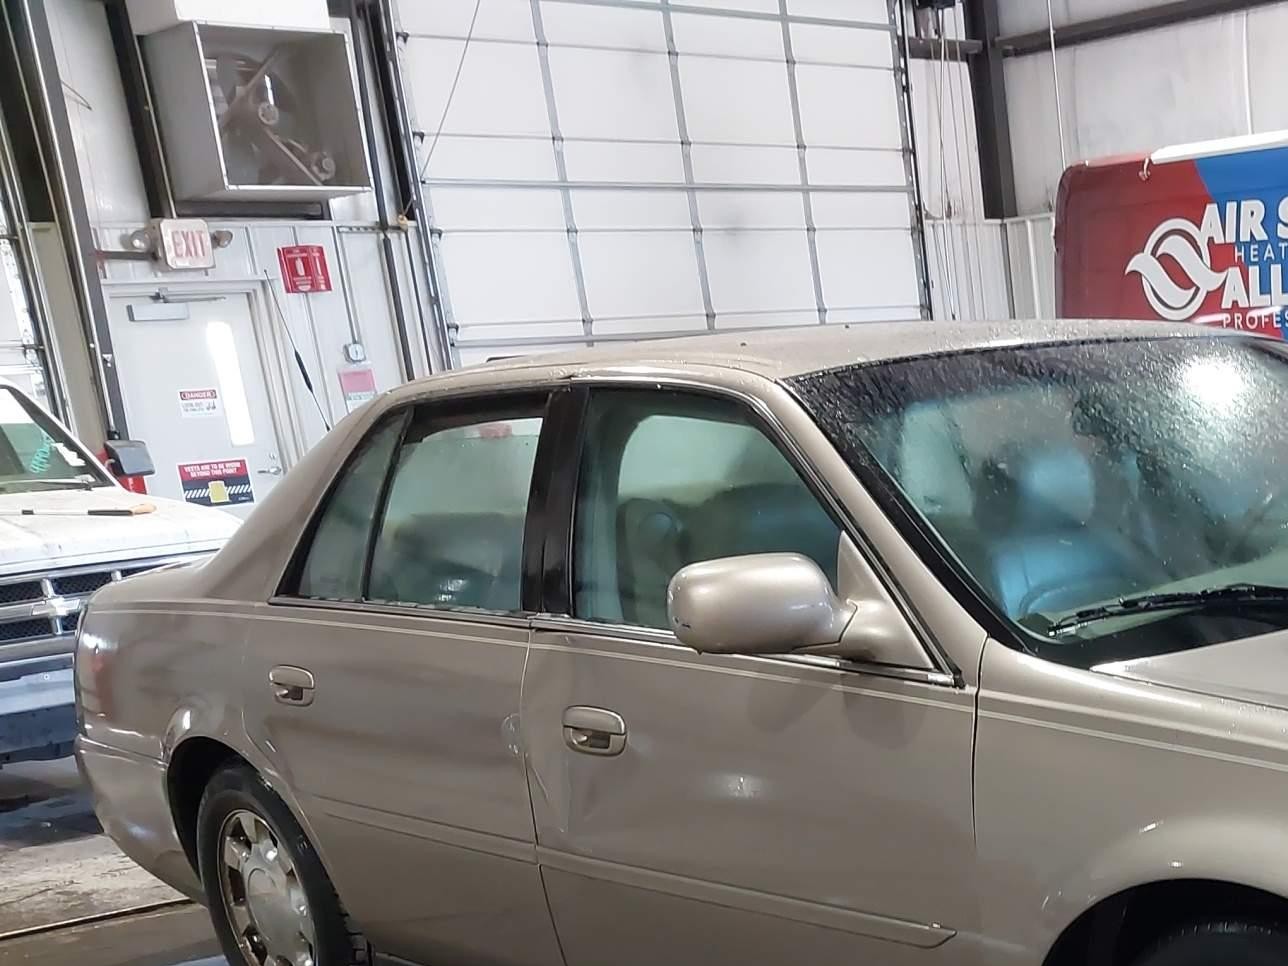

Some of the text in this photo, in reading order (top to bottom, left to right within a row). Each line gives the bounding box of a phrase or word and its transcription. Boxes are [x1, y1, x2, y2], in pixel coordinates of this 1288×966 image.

[1200, 199, 1268, 245] AIR
[171, 230, 206, 258] EXIT
[186, 390, 211, 399] DANGER
